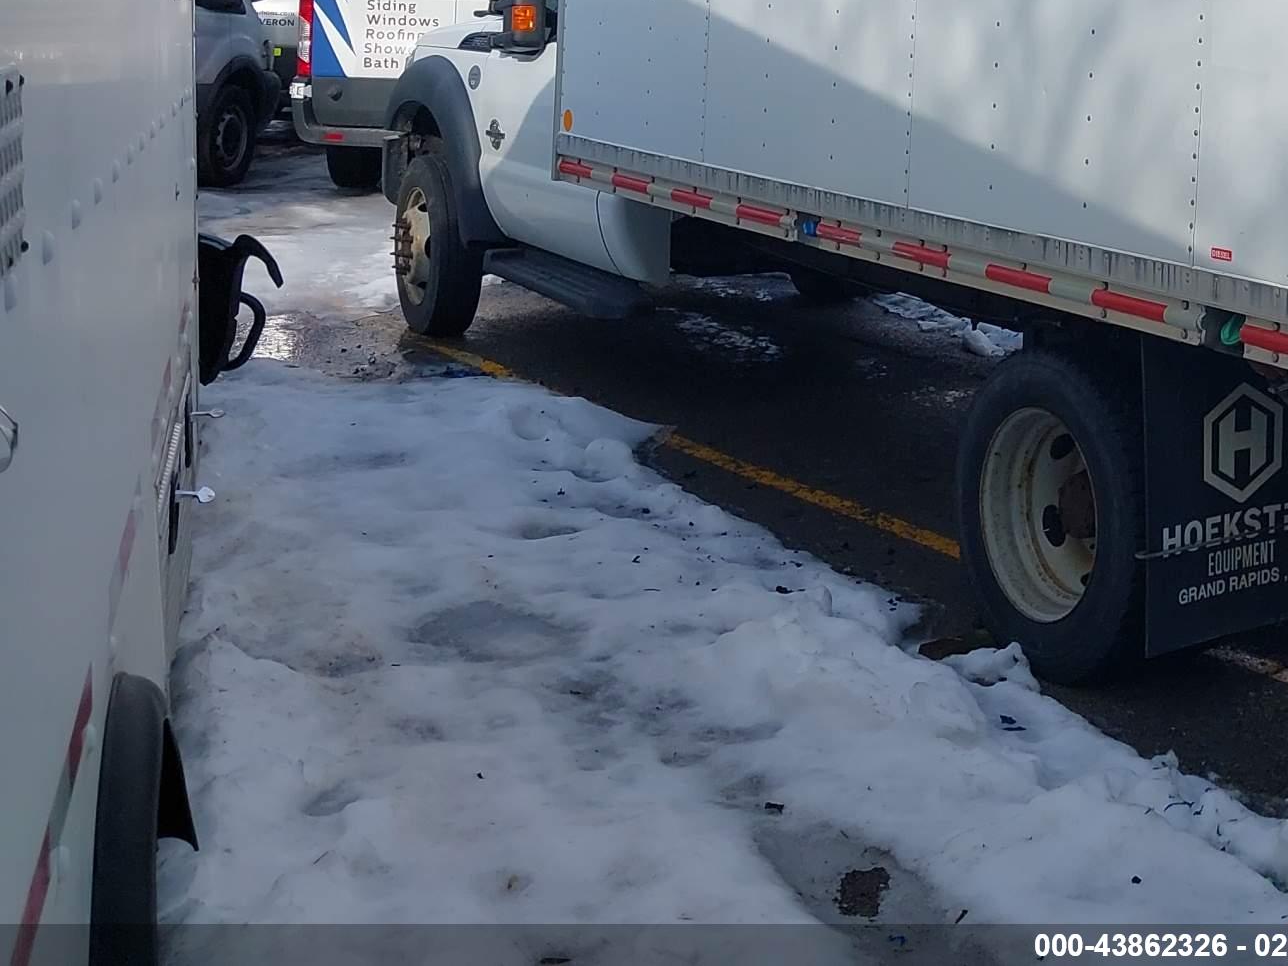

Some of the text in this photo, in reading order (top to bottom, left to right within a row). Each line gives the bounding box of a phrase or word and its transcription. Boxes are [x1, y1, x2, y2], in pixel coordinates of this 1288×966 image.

[367, 0, 416, 14] Siding
[366, 14, 439, 27] Windows
[363, 57, 399, 69] Bath
[1208, 539, 1276, 577] EQUIPMENT
[1178, 580, 1225, 605] GRAND
